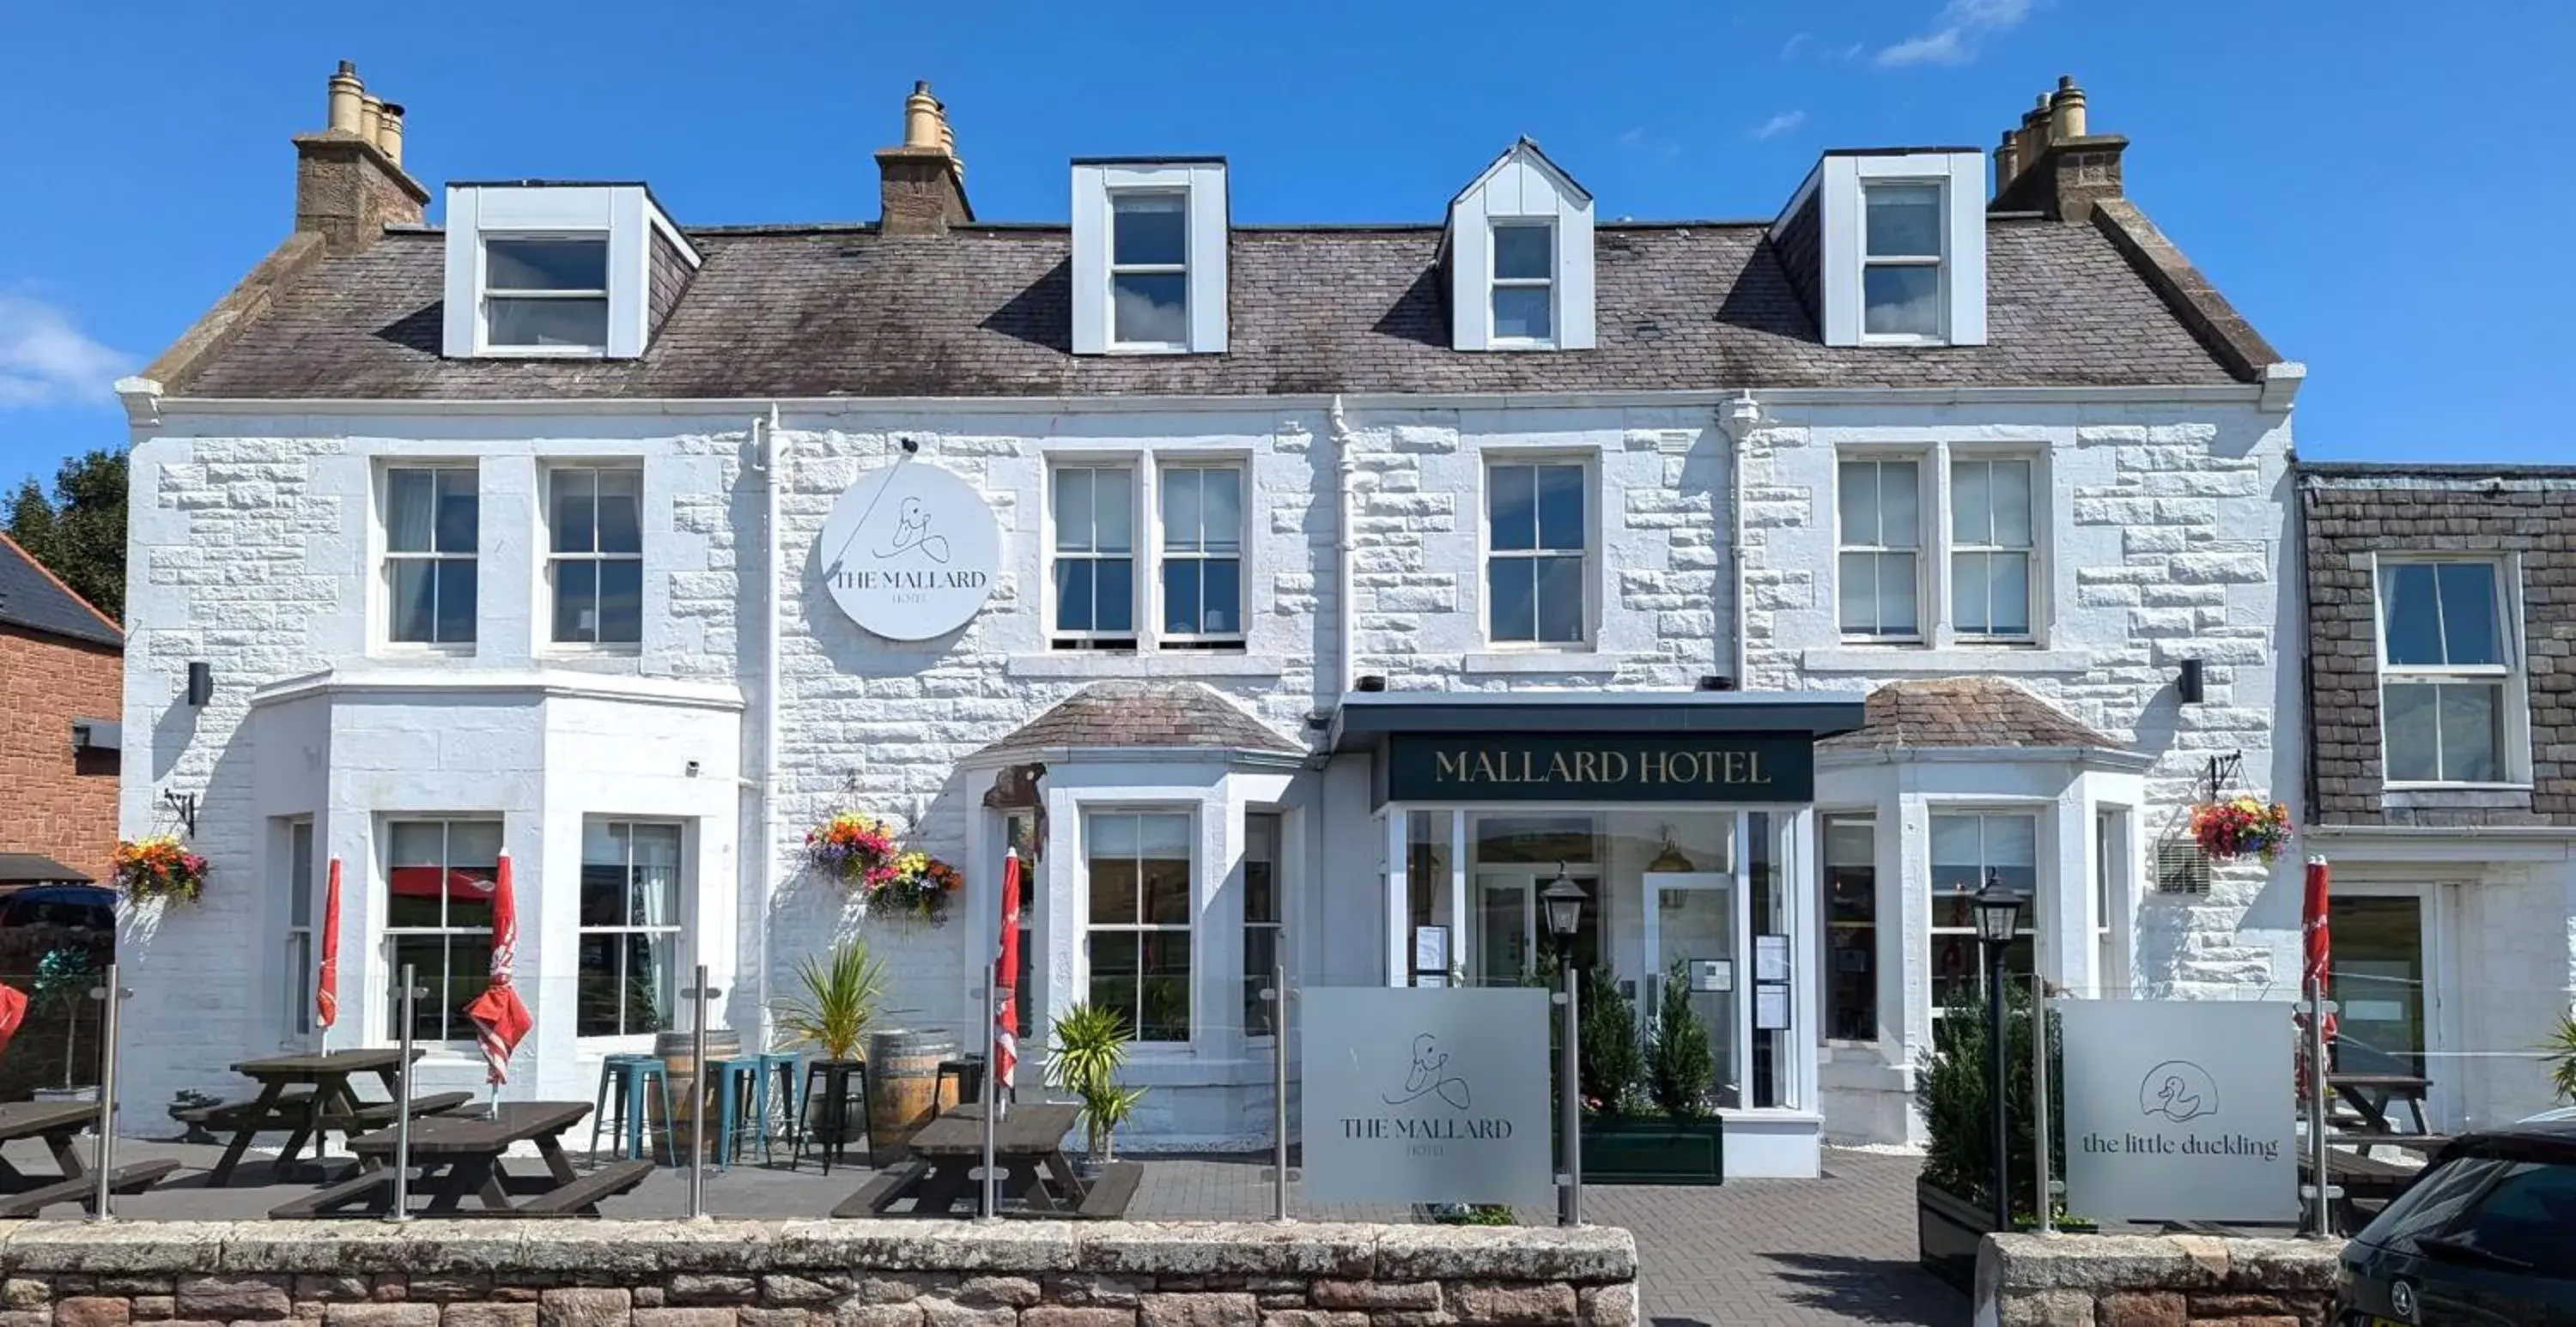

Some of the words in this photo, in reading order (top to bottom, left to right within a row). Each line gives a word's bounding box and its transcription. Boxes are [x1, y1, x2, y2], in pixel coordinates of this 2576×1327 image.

[835, 571, 877, 589] THE
[883, 571, 987, 589] MALLARD
[1435, 750, 1630, 783] MALLARD
[1639, 750, 1771, 784] HOTEL
[1340, 1118, 1388, 1138] THE
[1395, 1118, 1512, 1139] MALLARD
[2083, 1132, 2118, 1153] the
[2124, 1132, 2176, 1154] little
[2182, 1133, 2278, 1161] duckling
